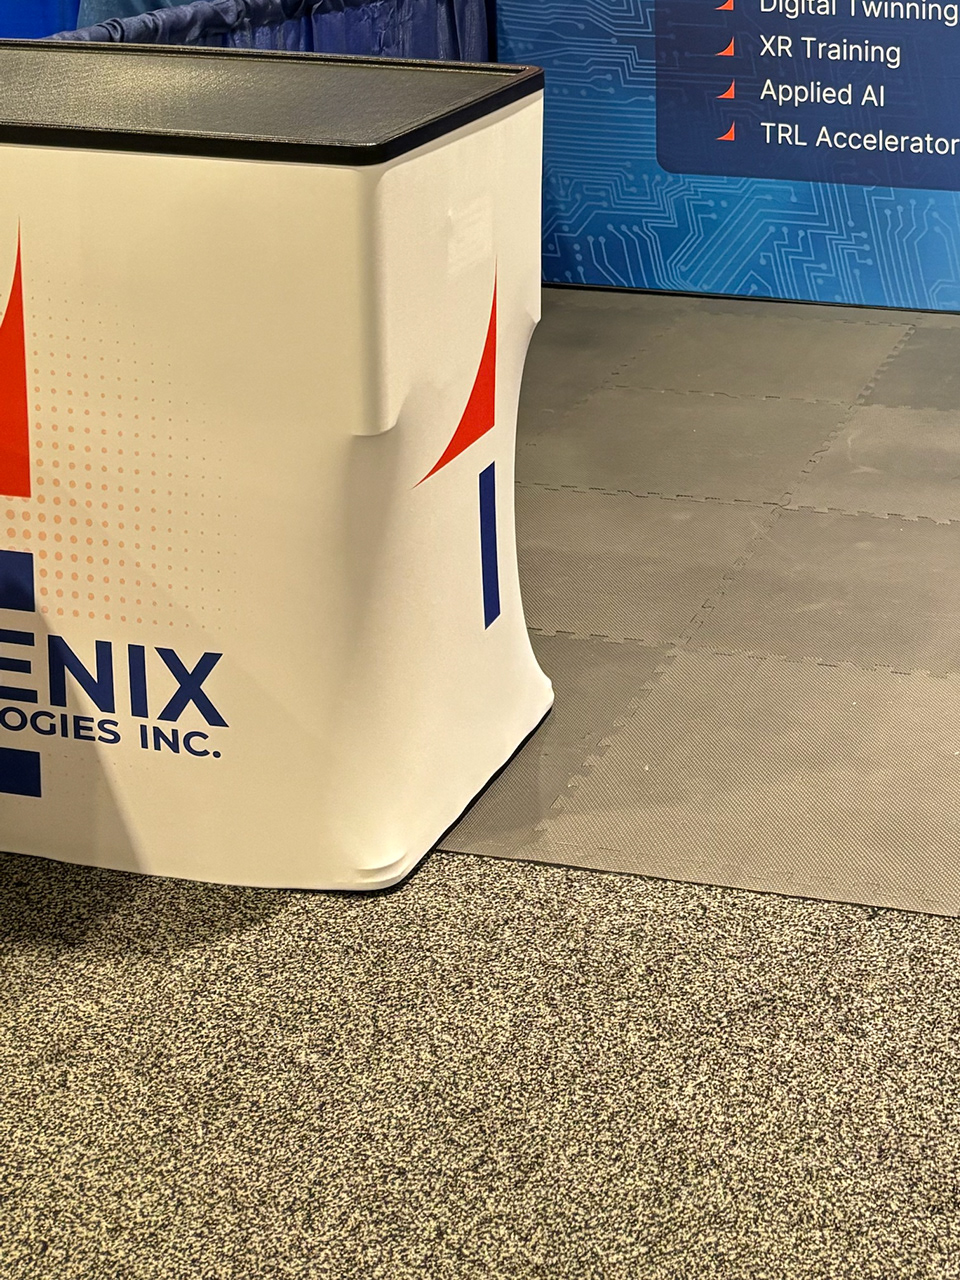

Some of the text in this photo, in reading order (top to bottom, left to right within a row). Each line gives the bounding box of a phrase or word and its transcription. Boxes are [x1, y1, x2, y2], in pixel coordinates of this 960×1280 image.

[759, 35, 901, 69] XR Training
[760, 78, 885, 107] Applied AI
[760, 123, 960, 155] TRL Accelerator
[0, 706, 222, 759] OGIES INC.
